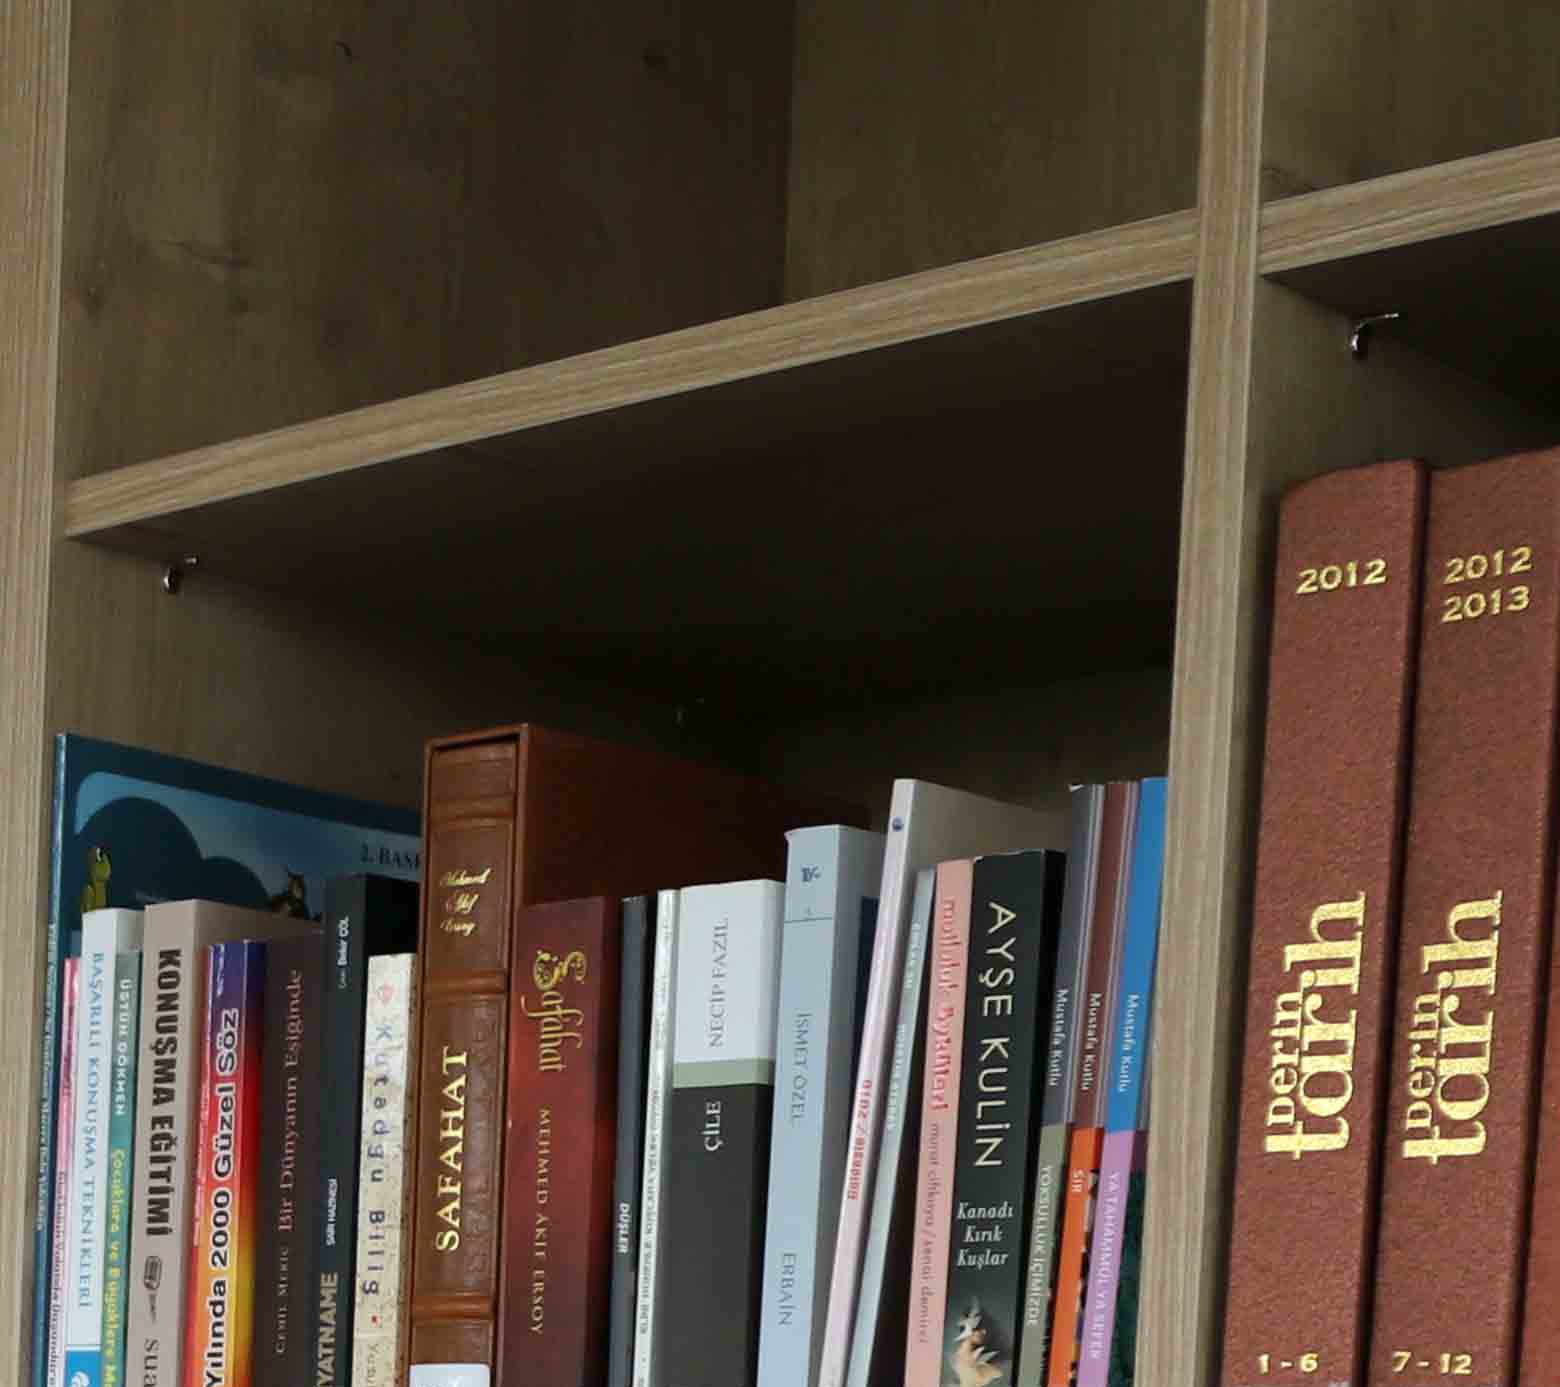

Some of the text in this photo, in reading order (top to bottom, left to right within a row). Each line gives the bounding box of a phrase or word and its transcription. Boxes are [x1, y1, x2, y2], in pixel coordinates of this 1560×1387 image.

[1296, 558, 1388, 594] 2012
[1441, 586, 1532, 622] 2013
[1443, 545, 1534, 583] 2012
[709, 918, 728, 1048] NECİP FAZIL
[1265, 891, 1366, 1159] tarih
[790, 1011, 811, 1123] İSMET ÖZEL
[975, 900, 1016, 1170] AYŞE KULİN
[1046, 988, 1070, 1086] Mustafa Kutlu
[1080, 993, 1102, 1091] Mustafa Kutlu
[1117, 994, 1140, 1093] Mustafa Kutlu
[1403, 890, 1503, 1164] tarih
[145, 948, 183, 1238] KONUŞMA EĞİTİMİ
[703, 1101, 723, 1153] ÇİLE
[211, 1008, 239, 1268] 2000 Güzel Söz
[435, 1044, 469, 1253] SAFAHAT
[279, 1198, 296, 1231] Bir
[616, 1202, 630, 1254] DÜŞLER
[957, 1201, 1013, 1225] Kanadı
[963, 1224, 1002, 1248] Kırık
[528, 1268, 545, 1336] ERSOY
[777, 1252, 796, 1328] ERBAİN
[956, 1246, 1009, 1271] Kuşlar
